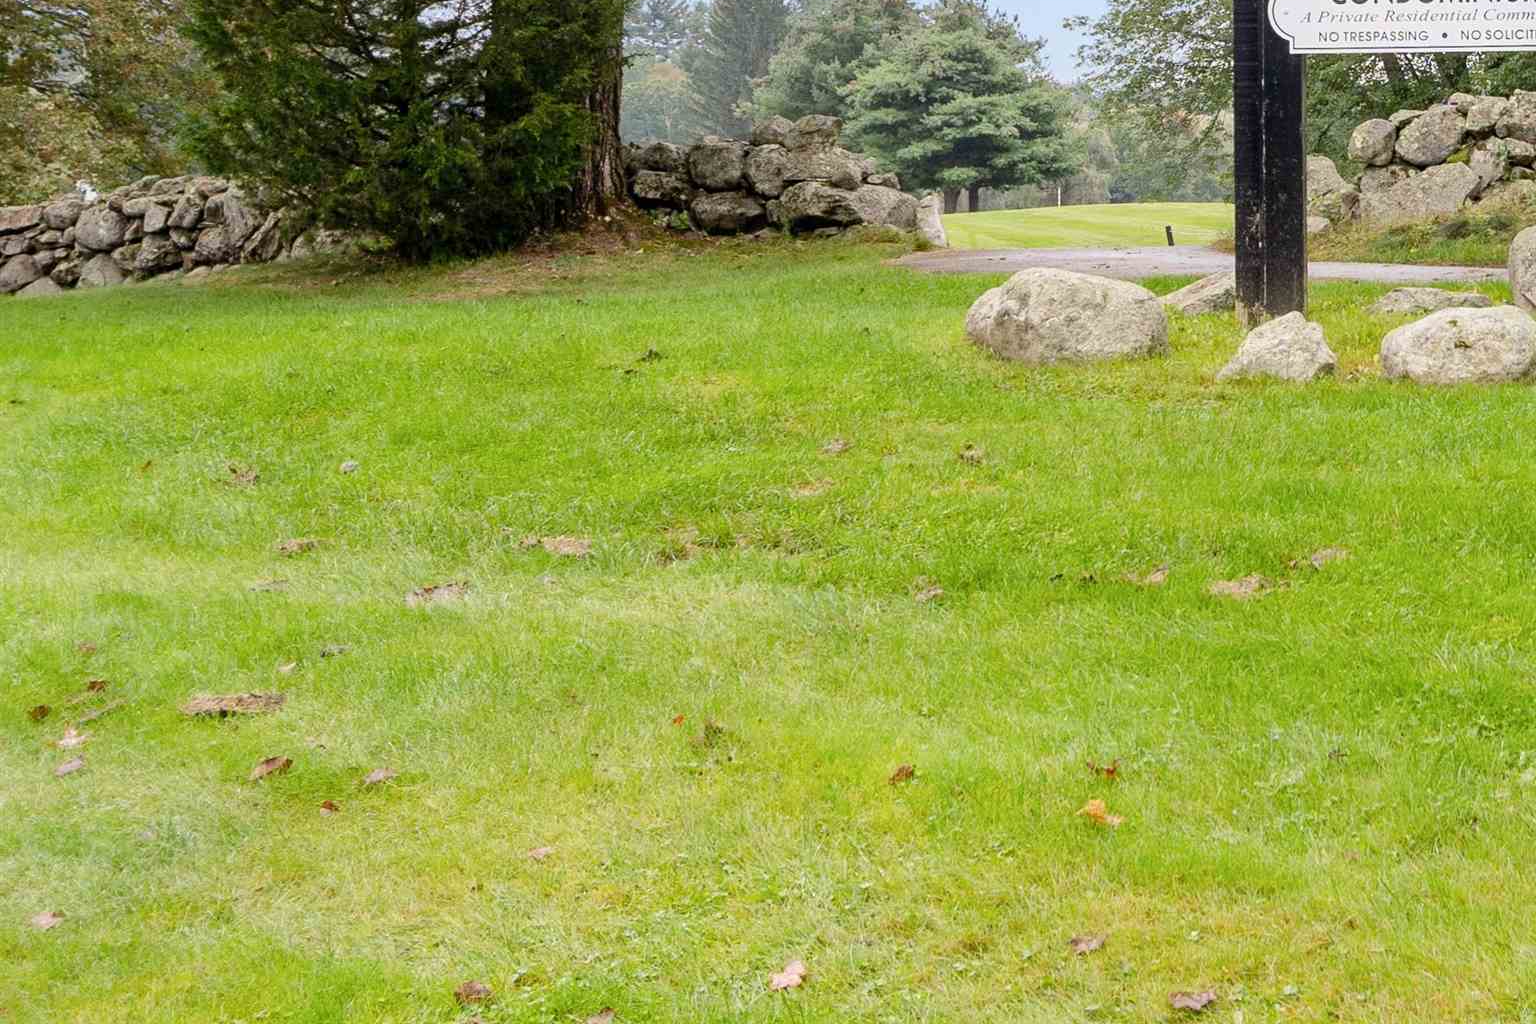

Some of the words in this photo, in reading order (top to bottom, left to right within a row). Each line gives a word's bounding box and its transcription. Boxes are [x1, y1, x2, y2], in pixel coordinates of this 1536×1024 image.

[1300, 11, 1312, 23] A
[1317, 10, 1378, 23] Private
[1384, 8, 1478, 23] Residential
[1318, 31, 1340, 43] NO
[1343, 30, 1429, 42] TRESPASSING
[1460, 29, 1482, 41] NO
